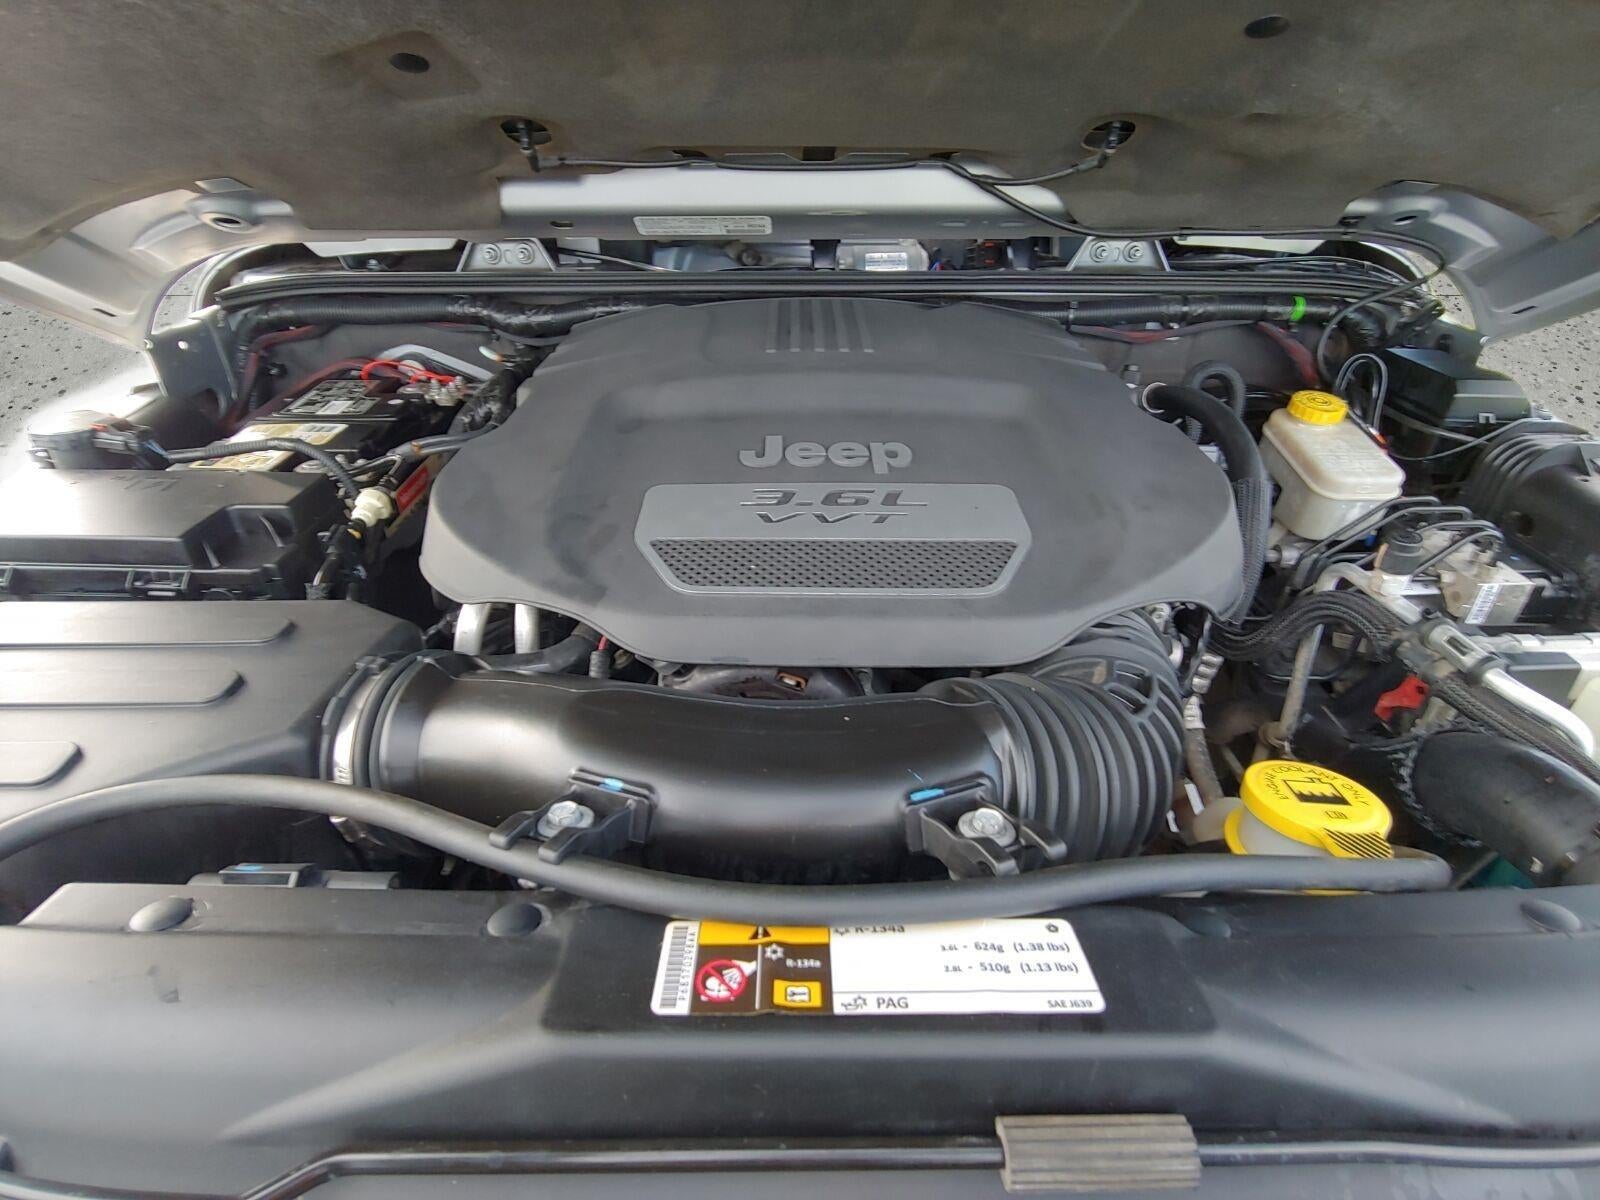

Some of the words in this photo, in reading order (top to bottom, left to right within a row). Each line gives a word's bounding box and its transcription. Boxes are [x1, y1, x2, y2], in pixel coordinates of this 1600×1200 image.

[738, 435, 913, 474] Jeep
[740, 488, 928, 507] 3.6L
[755, 512, 909, 524] VVT
[974, 941, 1005, 953] 624g
[1013, 941, 1045, 953] (1.38
[1048, 941, 1070, 953] lbs)
[785, 958, 822, 968] R-134a
[979, 962, 1011, 974] 510g
[1020, 962, 1052, 974] (1.13
[1056, 962, 1079, 974] lbs)
[876, 996, 909, 1009] PAG
[1047, 999, 1067, 1008] SAE
[1070, 999, 1093, 1008] J639
